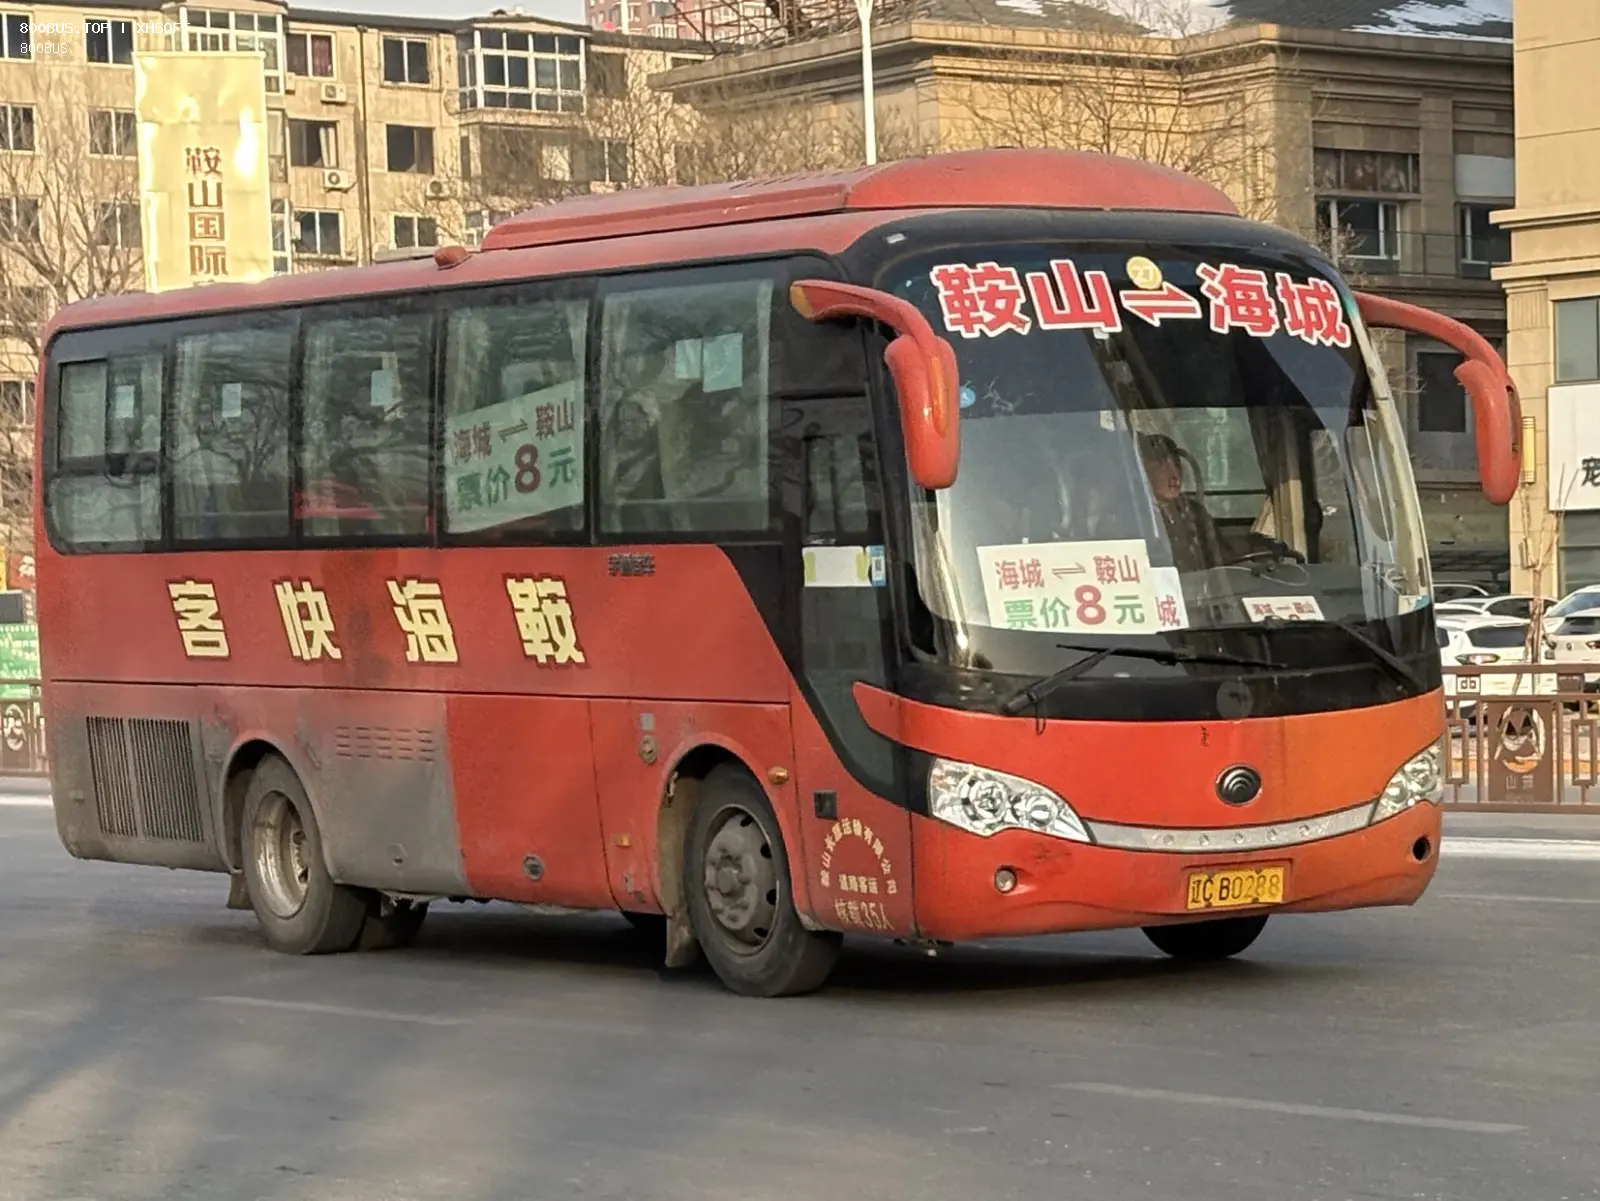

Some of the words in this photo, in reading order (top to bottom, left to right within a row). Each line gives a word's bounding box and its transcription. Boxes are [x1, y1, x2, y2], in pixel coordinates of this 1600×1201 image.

[186, 147, 228, 286] 鞍山国际
[931, 260, 1122, 338] 鞍山
[1197, 263, 1351, 347] 海城
[995, 558, 1045, 590] 海城
[1093, 554, 1141, 585] 鞍山
